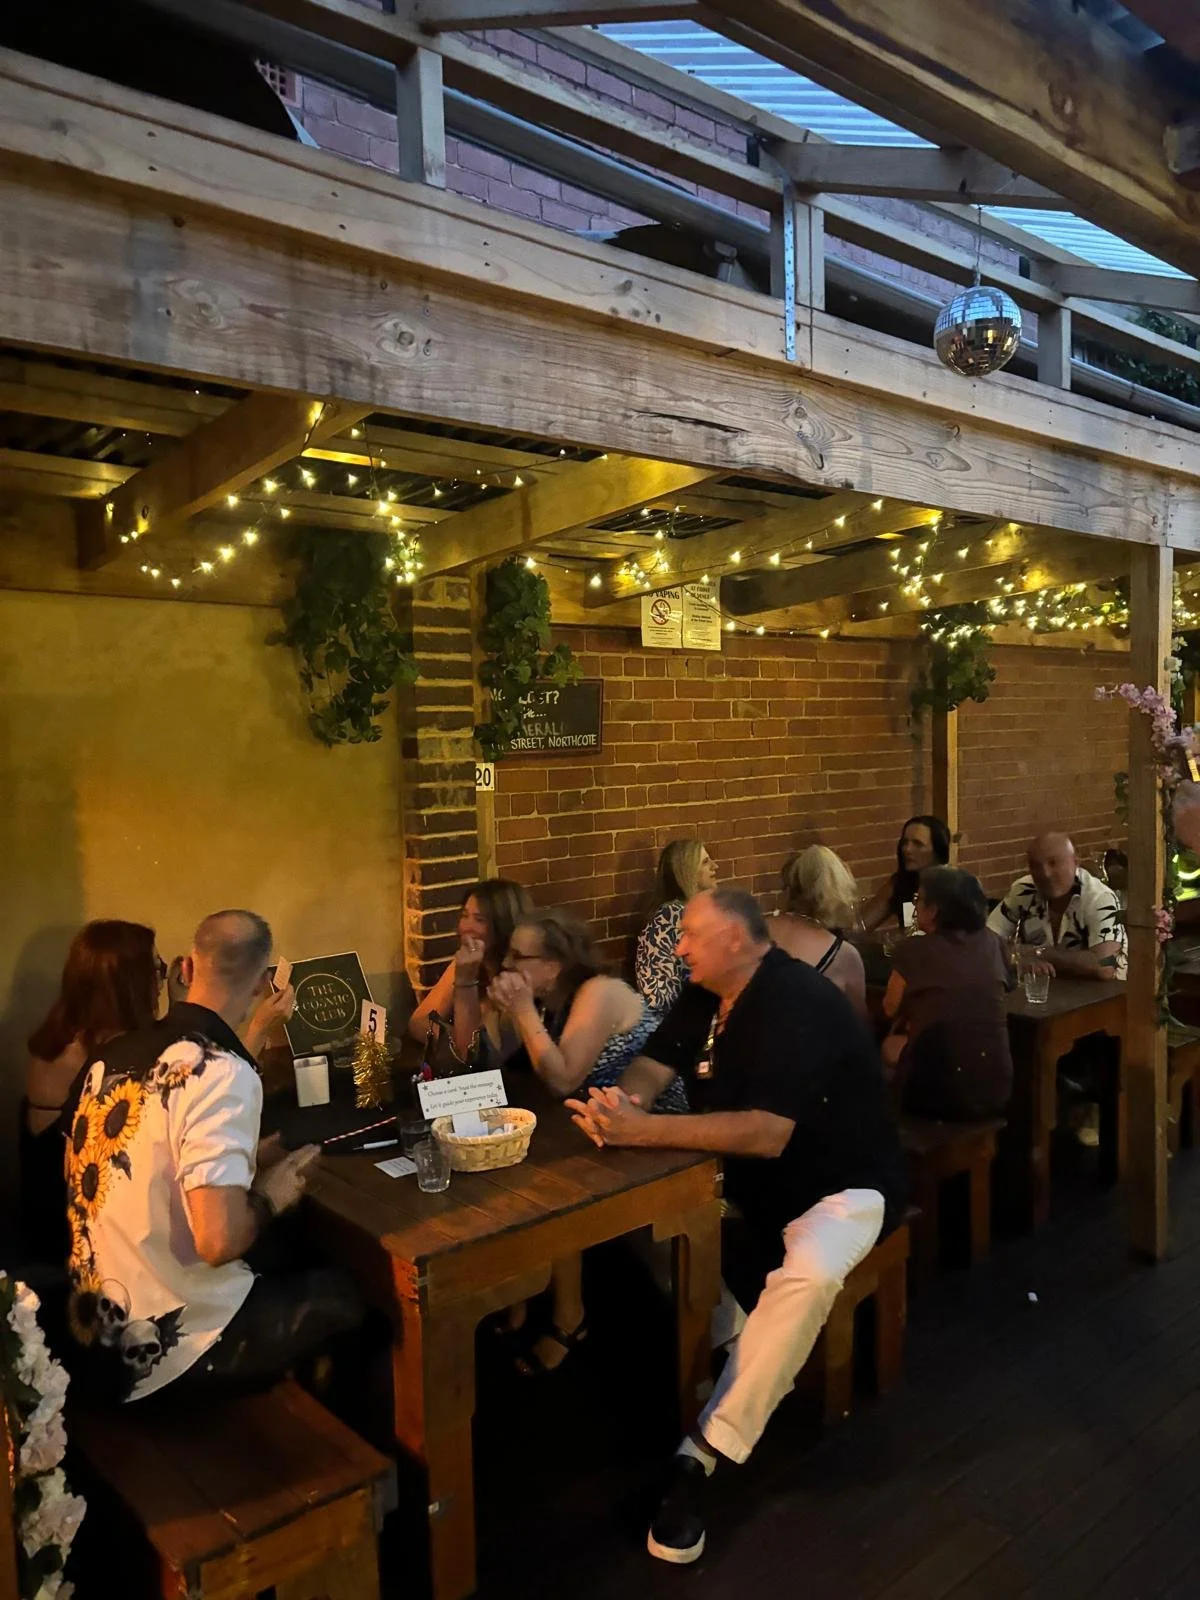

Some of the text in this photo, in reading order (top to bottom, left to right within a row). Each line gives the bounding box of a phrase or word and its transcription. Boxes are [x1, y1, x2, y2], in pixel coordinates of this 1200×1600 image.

[655, 590, 680, 600] VAPING
[510, 737, 545, 750] STREET,
[548, 734, 597, 748] NORTHCOTE
[475, 767, 491, 787] 20
[307, 983, 334, 997] THE
[302, 994, 349, 1010] COSMIC
[314, 1008, 346, 1022] CLUB
[368, 1008, 378, 1033] 5
